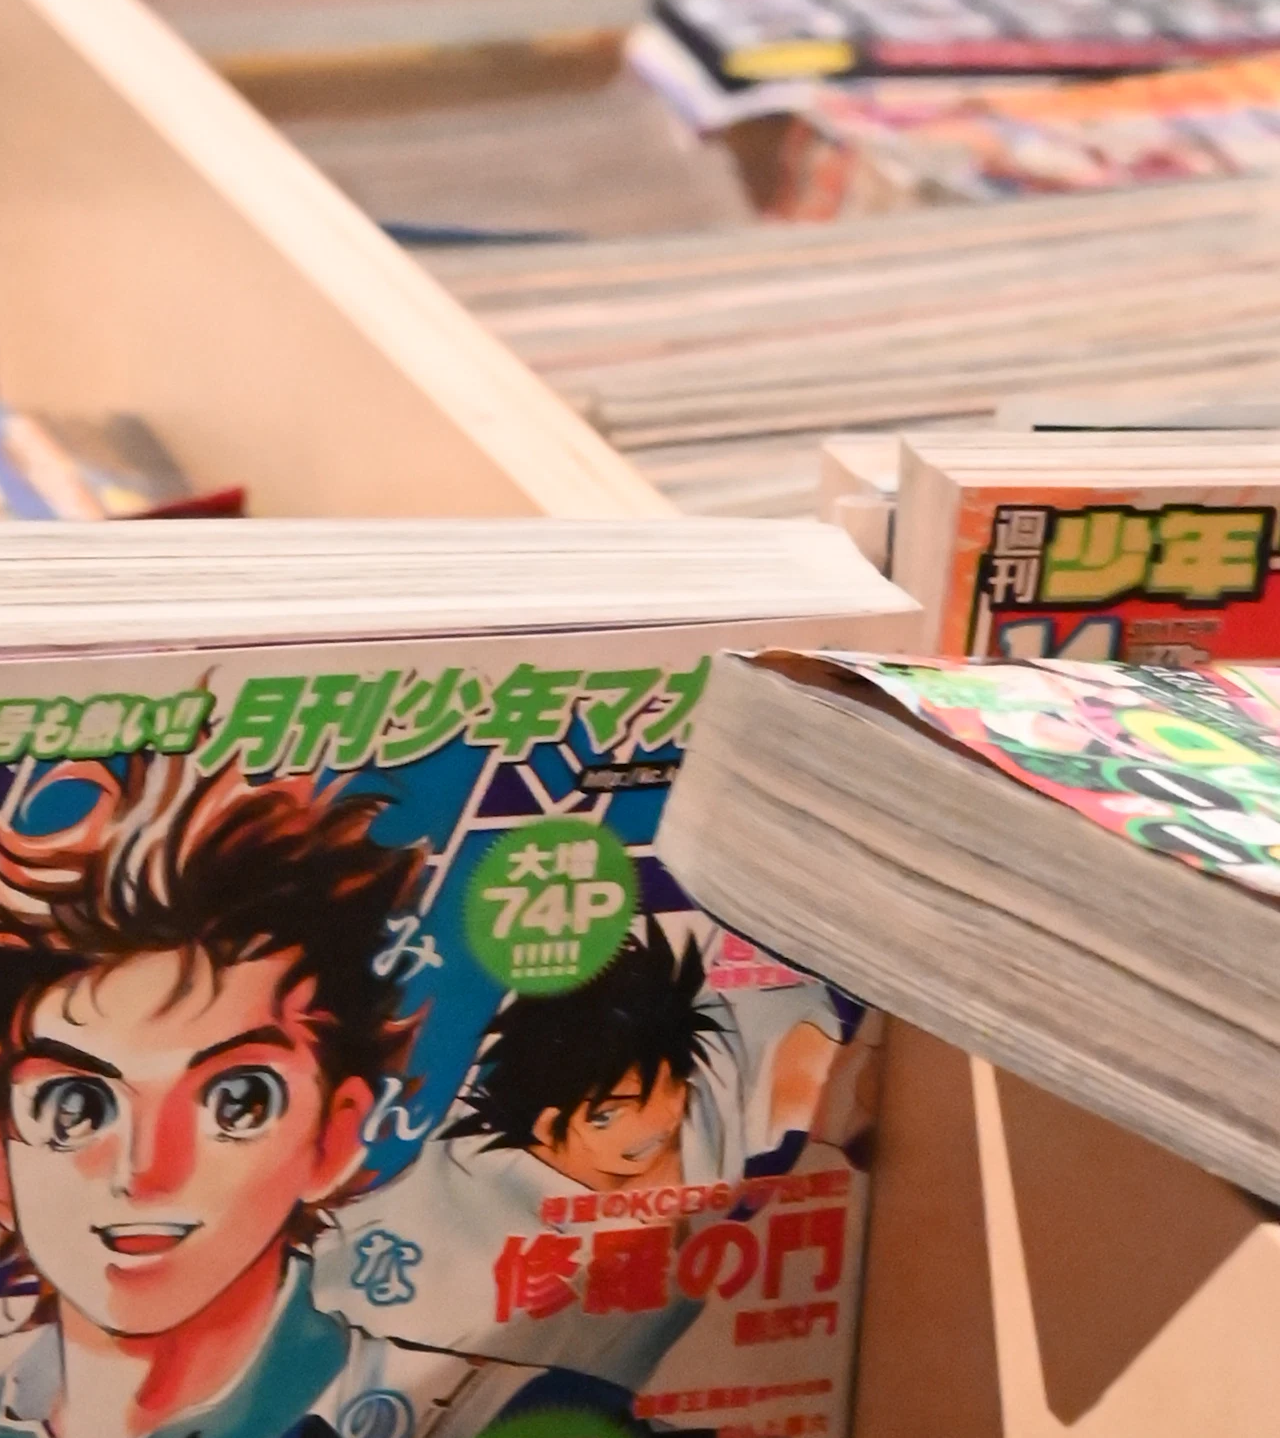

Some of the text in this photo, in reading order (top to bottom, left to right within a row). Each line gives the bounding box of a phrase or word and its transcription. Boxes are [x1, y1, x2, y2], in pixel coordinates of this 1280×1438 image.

[507, 838, 599, 881] 大増
[482, 879, 626, 940] 74P
[492, 1206, 850, 1323] 修羅の門
